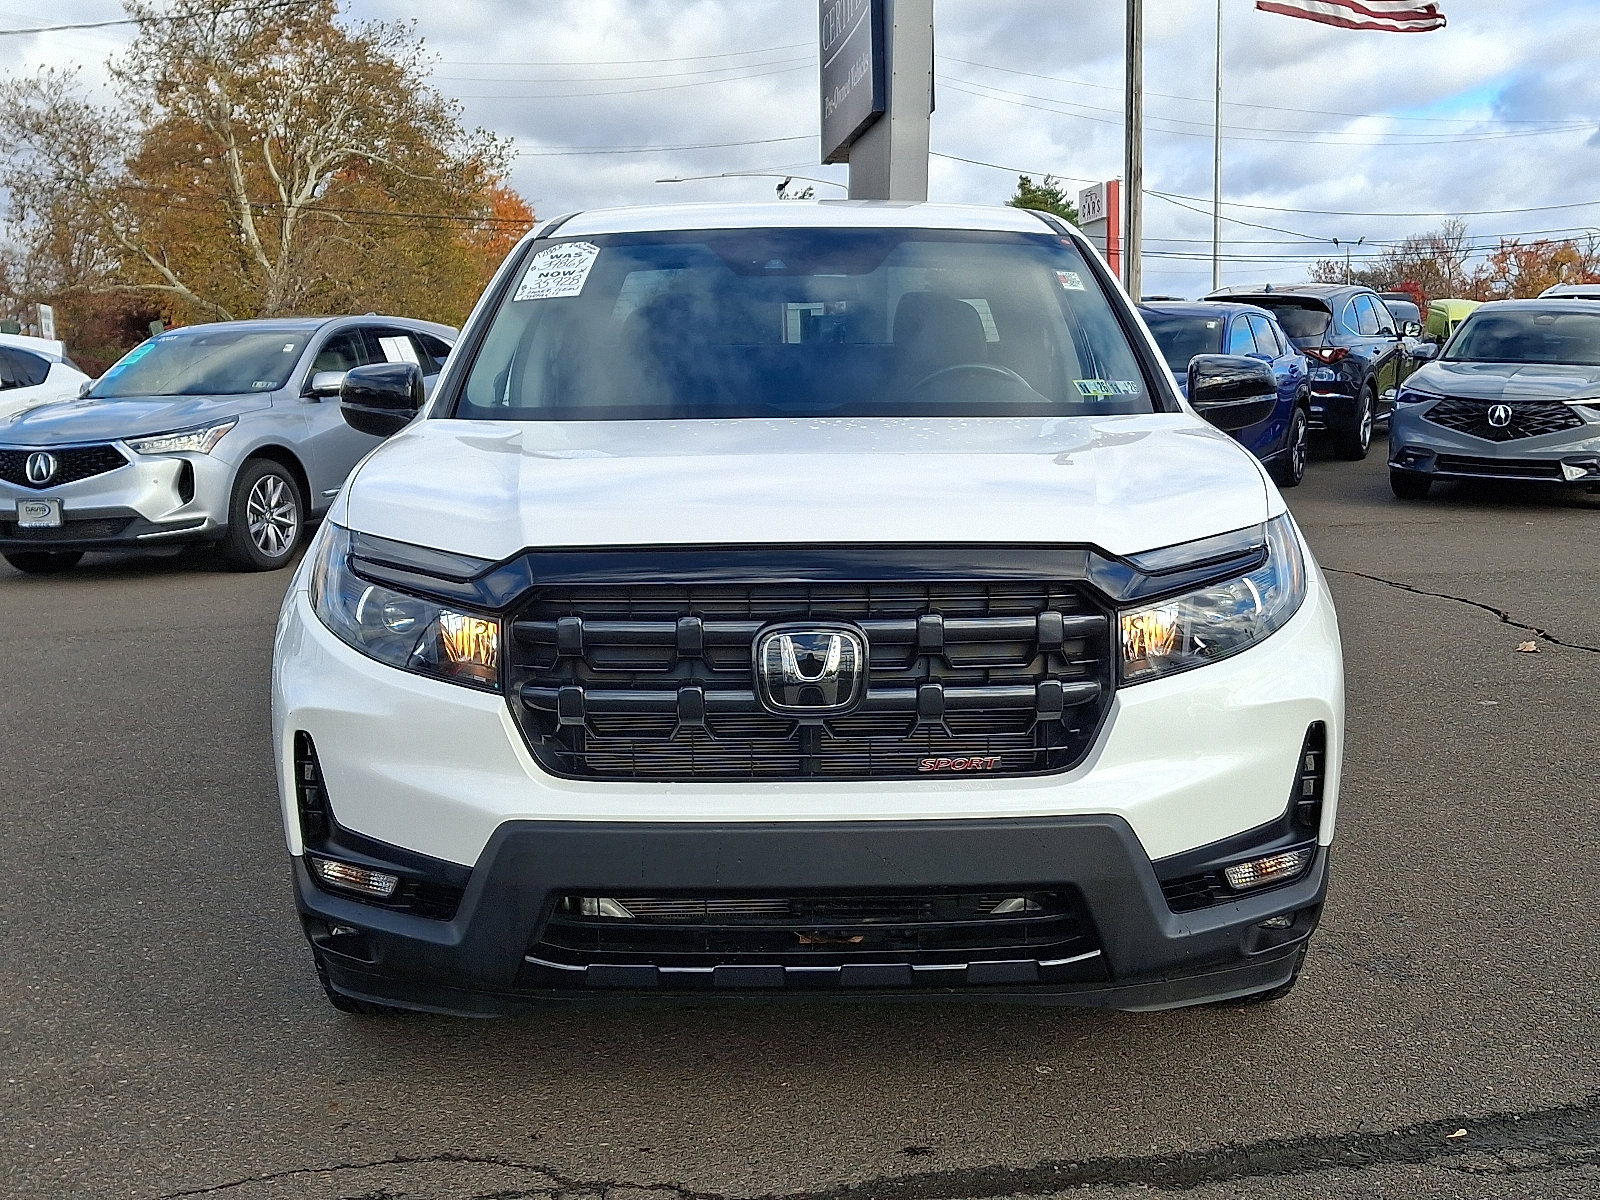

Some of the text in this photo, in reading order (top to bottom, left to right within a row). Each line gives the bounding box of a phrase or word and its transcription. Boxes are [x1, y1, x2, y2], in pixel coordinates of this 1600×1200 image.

[1083, 199, 1101, 218] CARS
[538, 270, 576, 278] NOW
[918, 756, 1001, 771] SPORT
